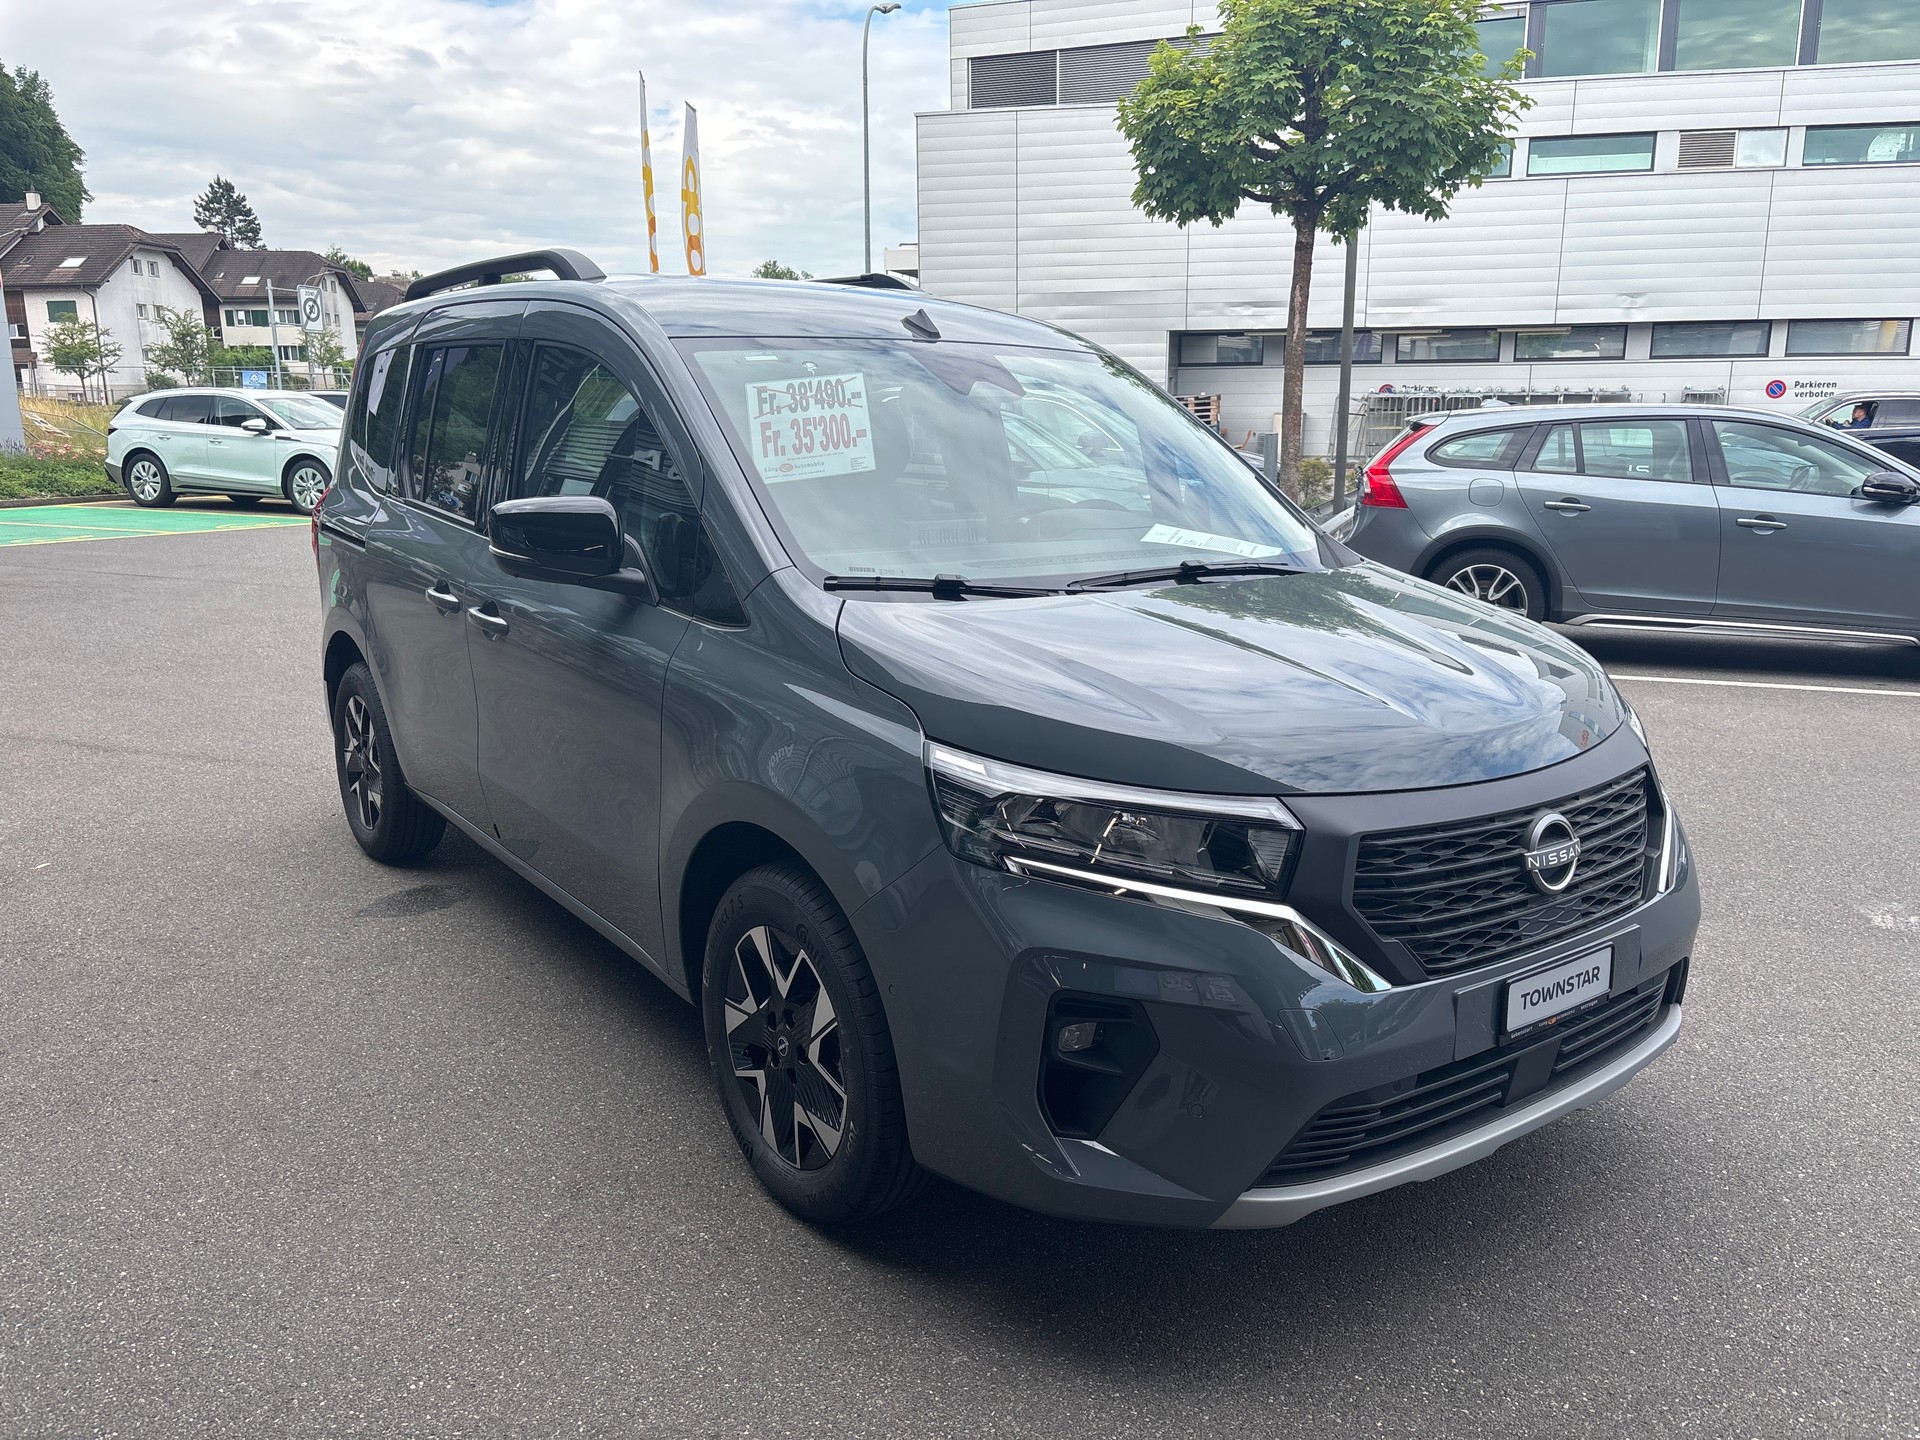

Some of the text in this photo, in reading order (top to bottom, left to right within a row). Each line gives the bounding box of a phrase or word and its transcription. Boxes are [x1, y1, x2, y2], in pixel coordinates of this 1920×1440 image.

[756, 385, 781, 416] Fr.
[1794, 390, 1835, 398] verboten
[760, 421, 786, 458] Fr.
[1527, 844, 1581, 868] NISSAN
[1520, 965, 1600, 1010] TOWNSTAR
